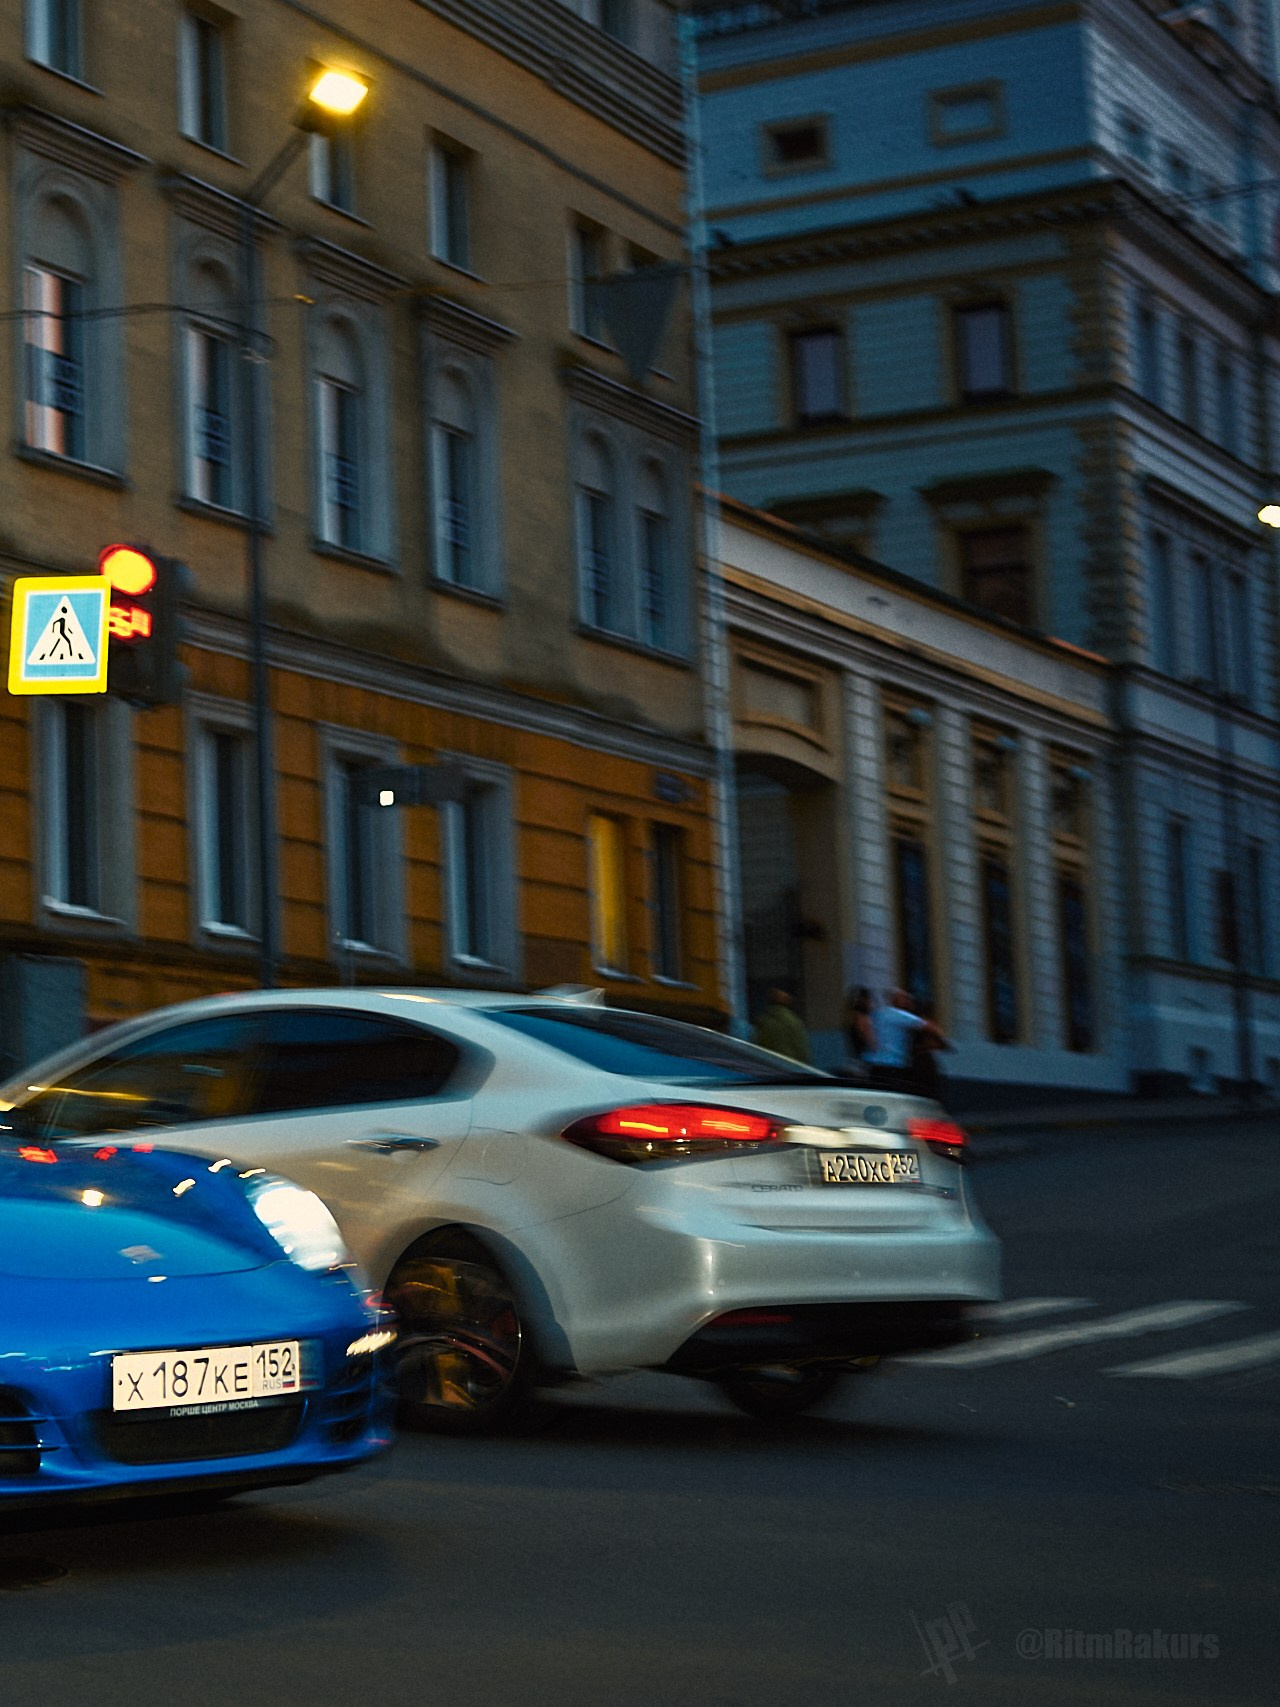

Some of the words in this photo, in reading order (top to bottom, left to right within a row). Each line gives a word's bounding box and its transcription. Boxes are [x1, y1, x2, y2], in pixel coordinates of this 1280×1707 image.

[826, 1155, 891, 1182] А250ХС
[891, 1153, 915, 1174] 252
[127, 1357, 249, 1402] Х187КЕ
[256, 1347, 292, 1378] 152
[262, 1377, 282, 1390] RUS
[170, 1405, 200, 1417] ПОРШЕ
[202, 1403, 227, 1414] ЦЕНТР
[228, 1400, 259, 1411] МОСКВА
